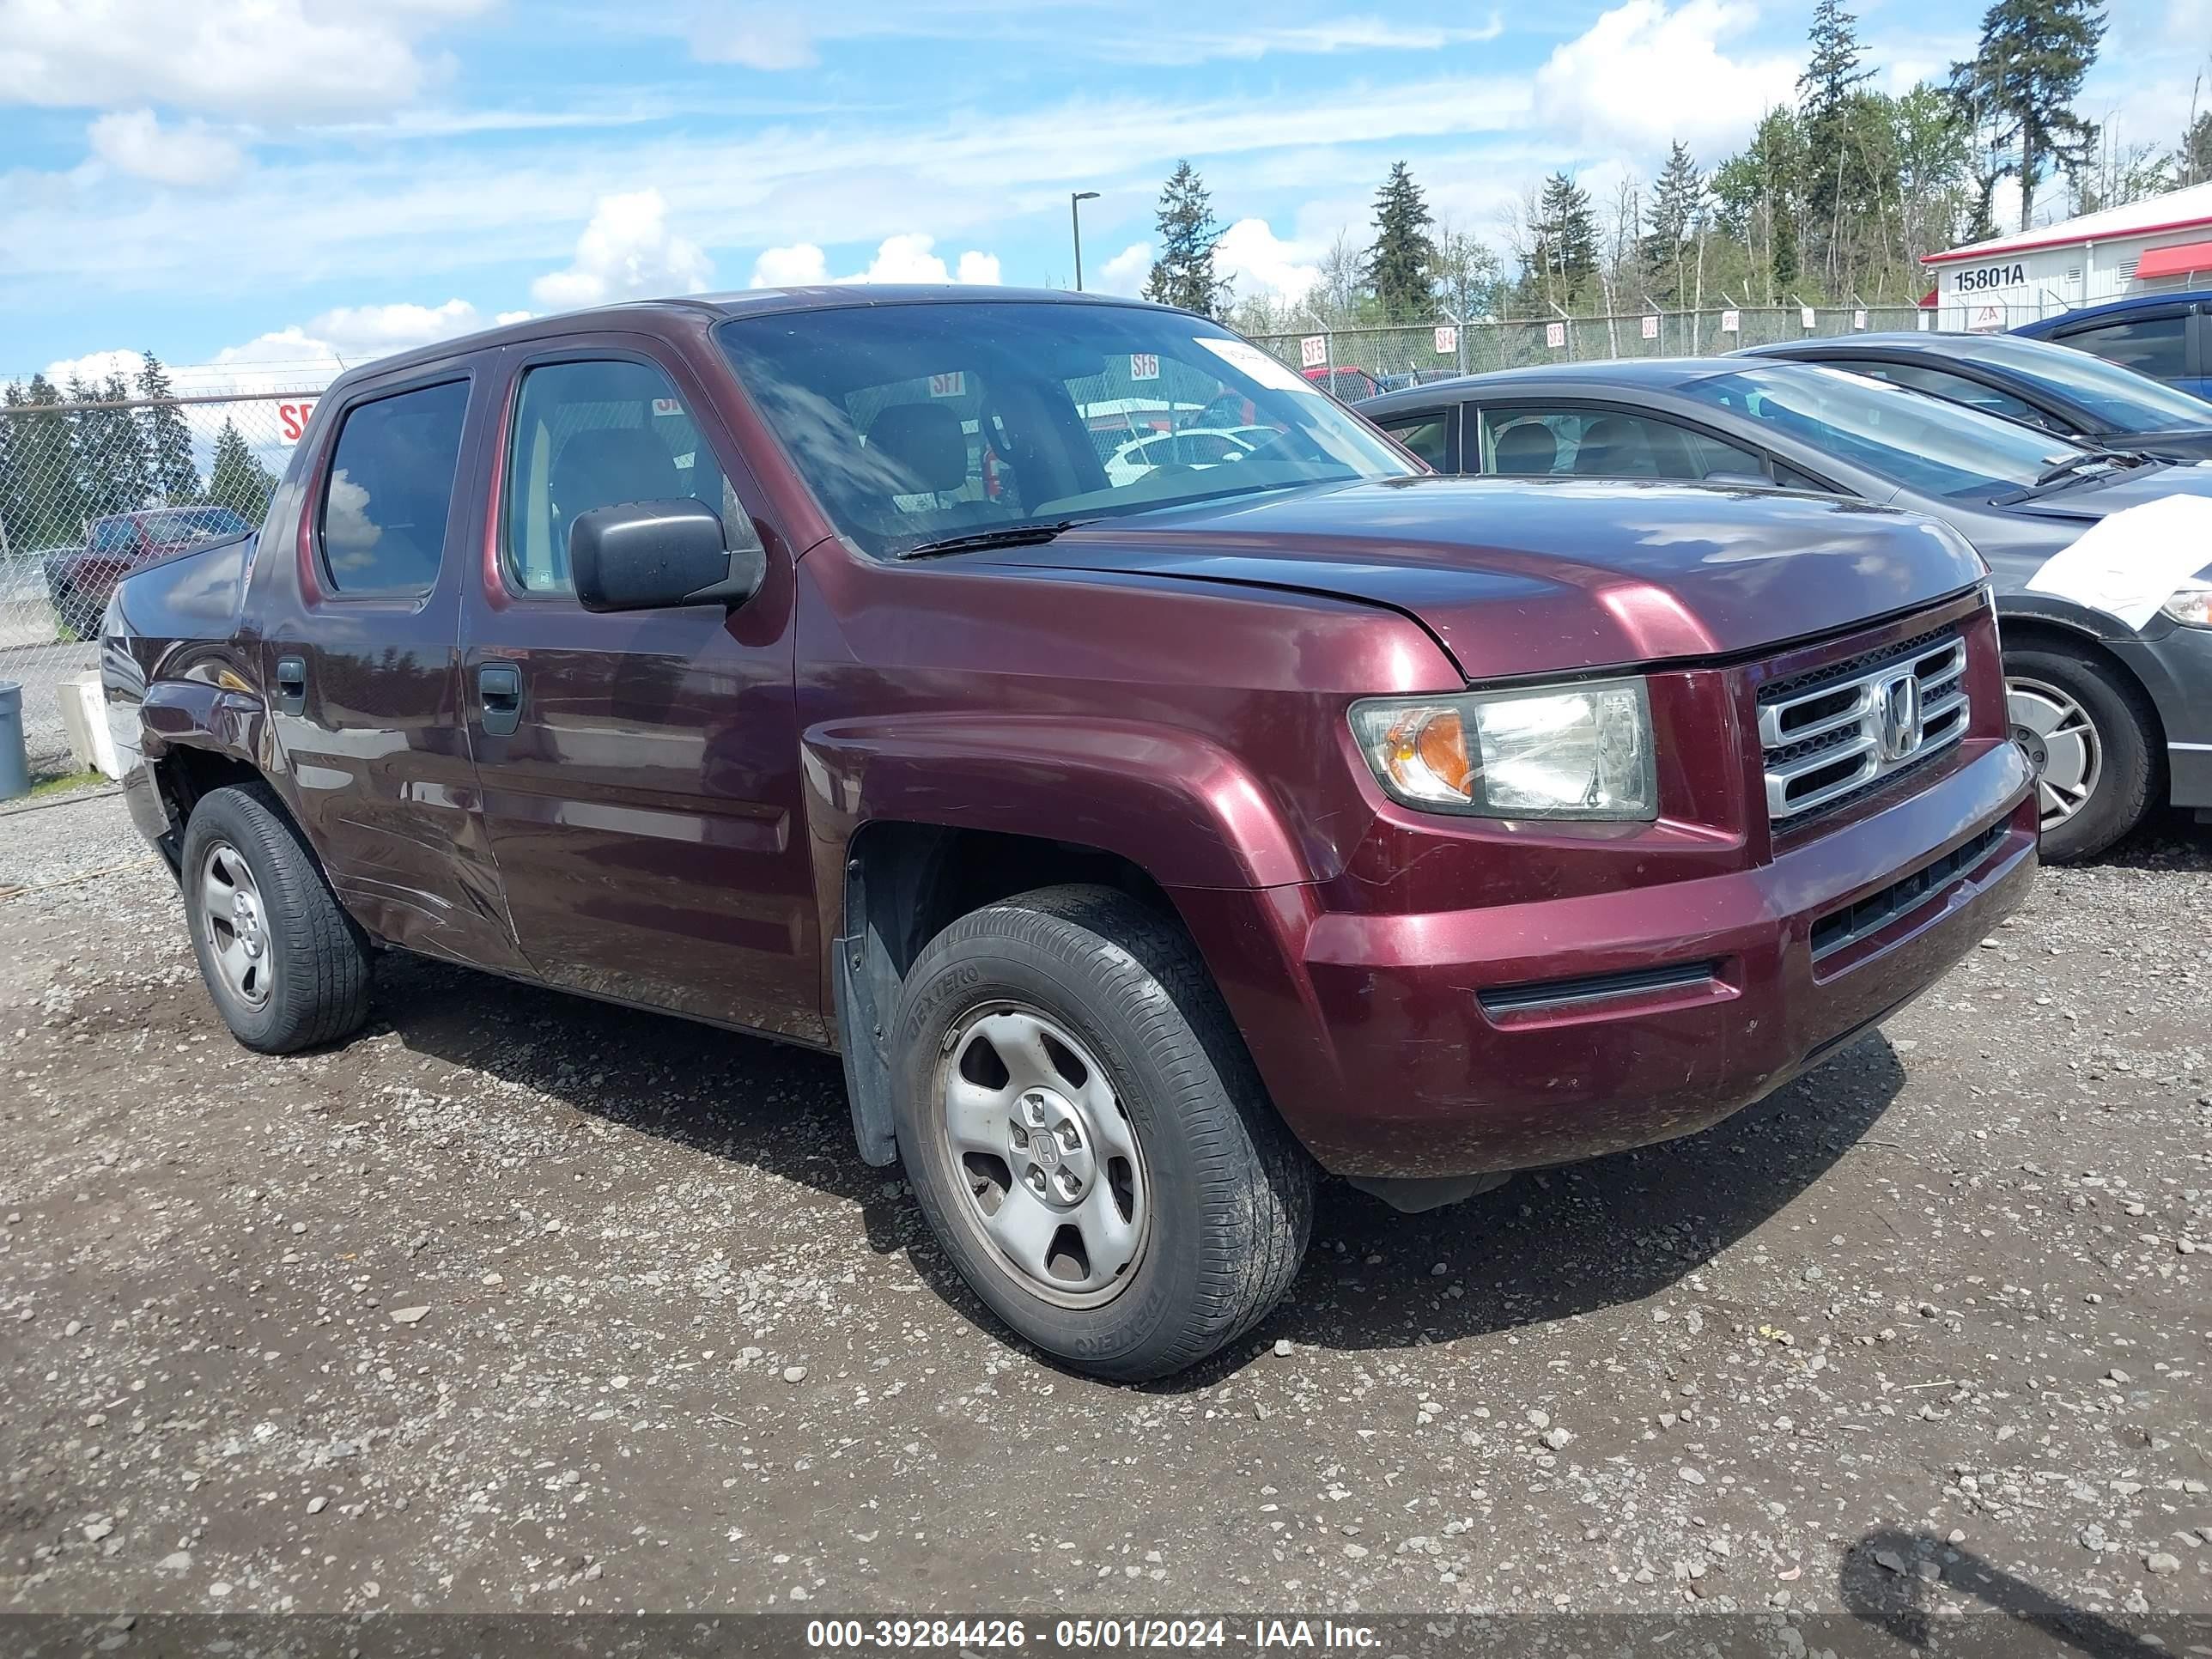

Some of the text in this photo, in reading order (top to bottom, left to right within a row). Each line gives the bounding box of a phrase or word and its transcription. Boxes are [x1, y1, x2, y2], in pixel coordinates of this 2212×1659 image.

[1954, 264, 2025, 291] 15801A
[1437, 328, 1454, 349] SF4
[1548, 325, 1563, 344] SF3
[1304, 339, 1324, 362] SF5
[1133, 354, 1157, 377] SF6
